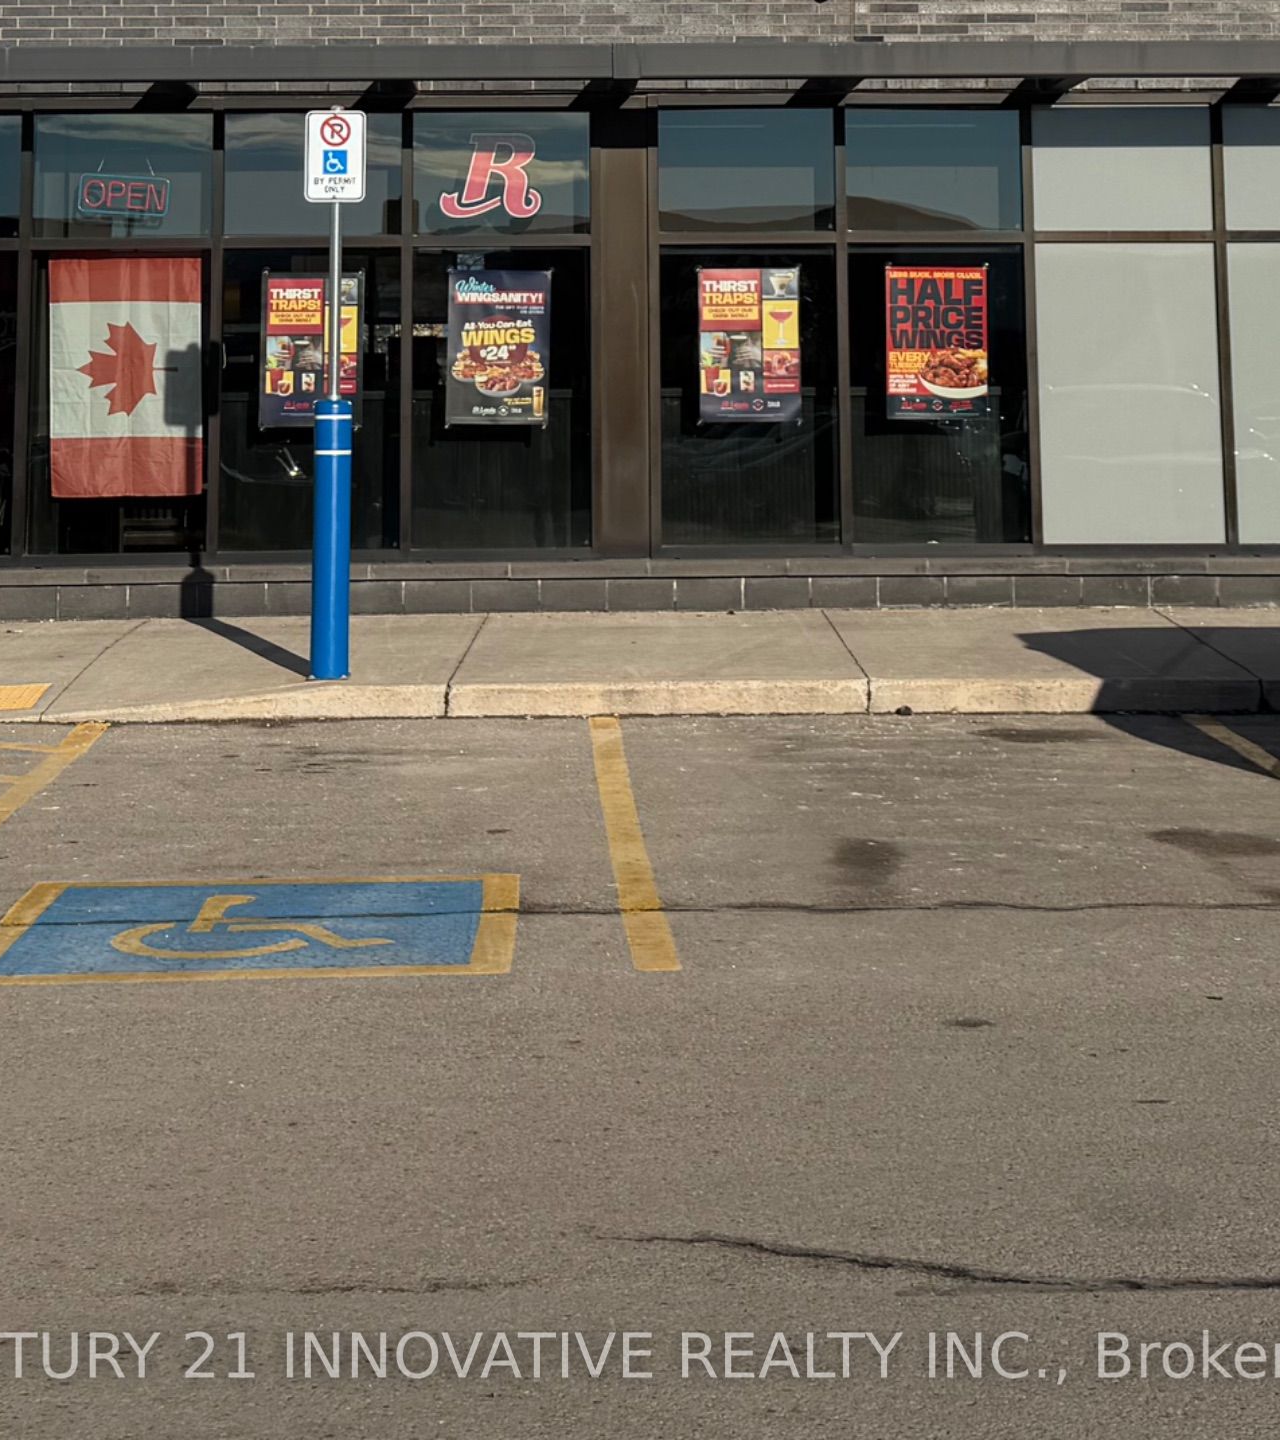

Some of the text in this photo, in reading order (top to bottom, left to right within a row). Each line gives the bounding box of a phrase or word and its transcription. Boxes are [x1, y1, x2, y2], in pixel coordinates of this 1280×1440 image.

[83, 179, 167, 211] OPEN
[703, 279, 758, 292] THIRST
[889, 278, 983, 305] HALF
[269, 288, 321, 300] THIRST
[457, 292, 544, 304] WINGSANITY!
[702, 292, 758, 305] TRAPS!
[269, 300, 321, 311] TRAPS!
[889, 305, 983, 329] PRICE
[461, 327, 536, 347] WINGS
[889, 329, 984, 349] WINGS
[889, 351, 931, 362] EVERY
